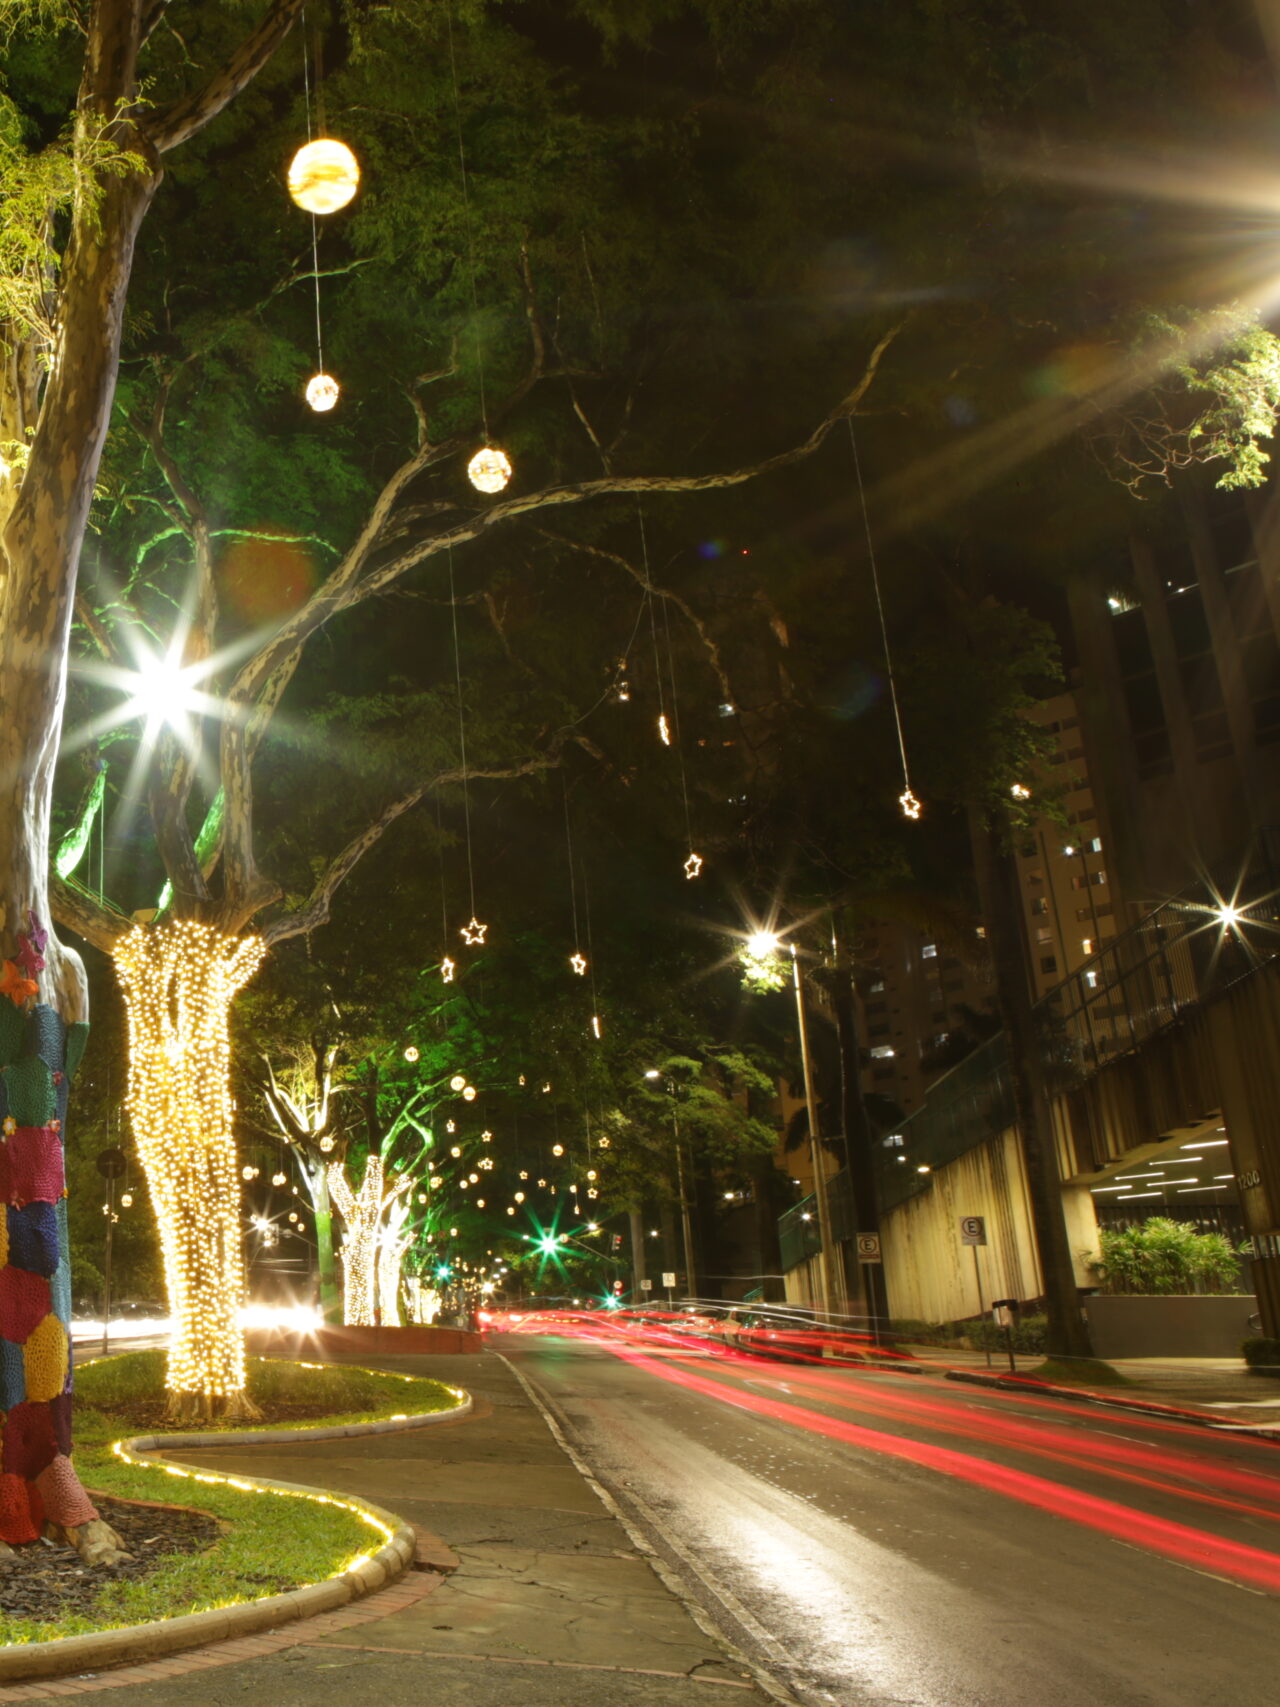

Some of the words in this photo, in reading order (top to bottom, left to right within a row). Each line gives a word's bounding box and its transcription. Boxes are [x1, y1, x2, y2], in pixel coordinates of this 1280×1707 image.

[1238, 1170, 1260, 1190] 1200
[968, 1221, 977, 1233] E
[865, 1240, 872, 1250] E
